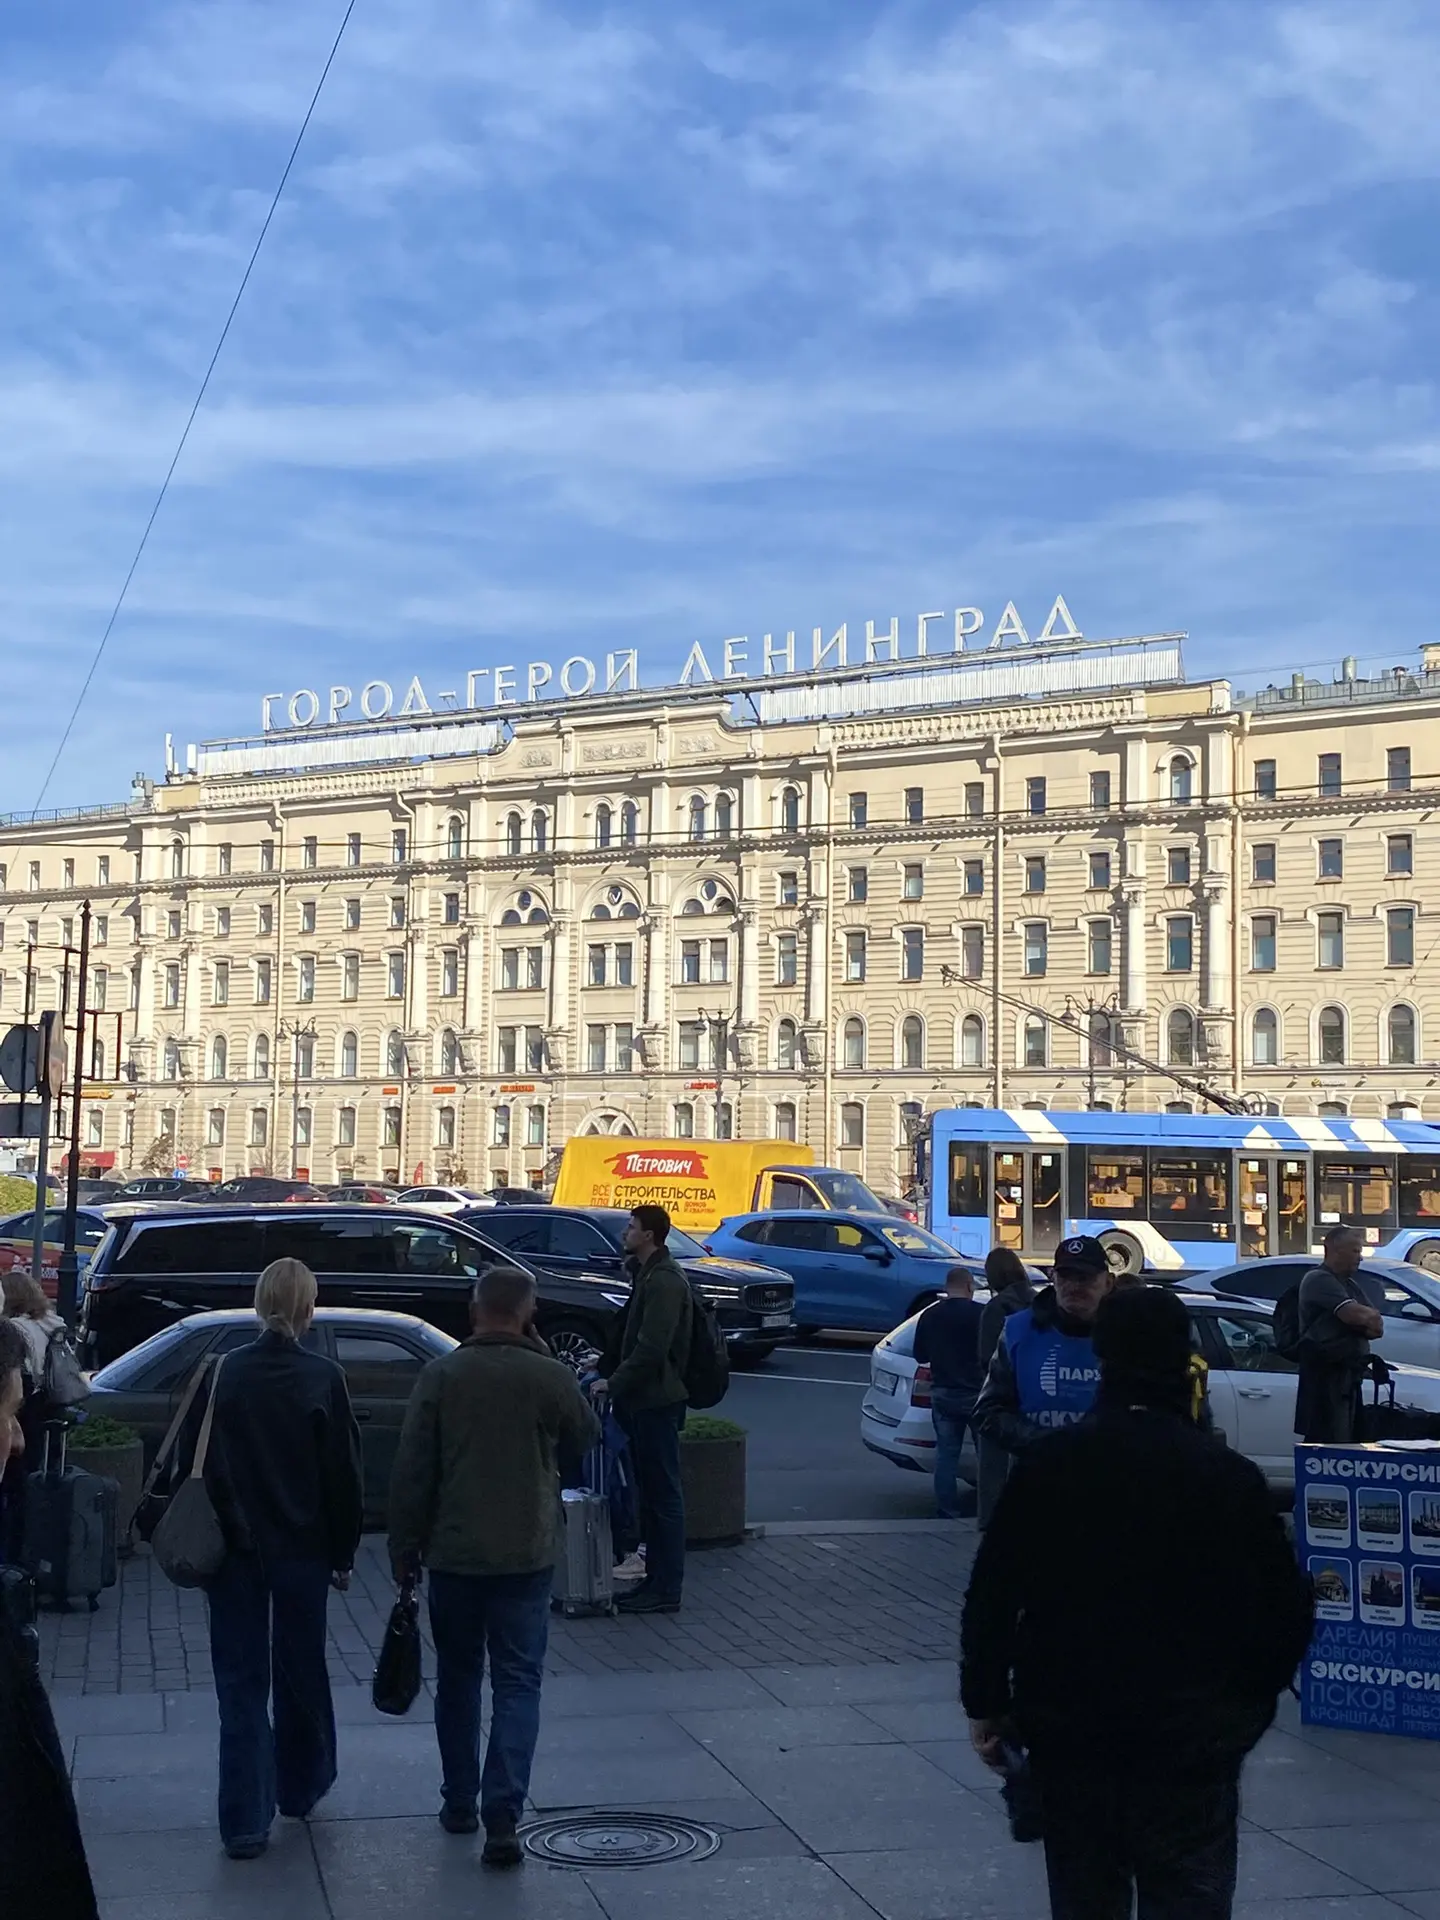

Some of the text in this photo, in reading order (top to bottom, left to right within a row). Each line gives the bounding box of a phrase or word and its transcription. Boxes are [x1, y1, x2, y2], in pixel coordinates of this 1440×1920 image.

[262, 593, 1084, 730] ГОРОД-ГЕРОЙ ЛЕНИНГРАД
[592, 1184, 610, 1196] ВСЕ
[614, 1185, 716, 1200] СТРОИТЕЛЬСТВА
[1304, 1456, 1440, 1484] ЭКСКУРСИ
[1310, 1660, 1440, 1691] ЭКСКУРСИ
[1310, 1681, 1397, 1712] ПСКОВ
[1310, 1704, 1397, 1729] КРОНШТАДТ
